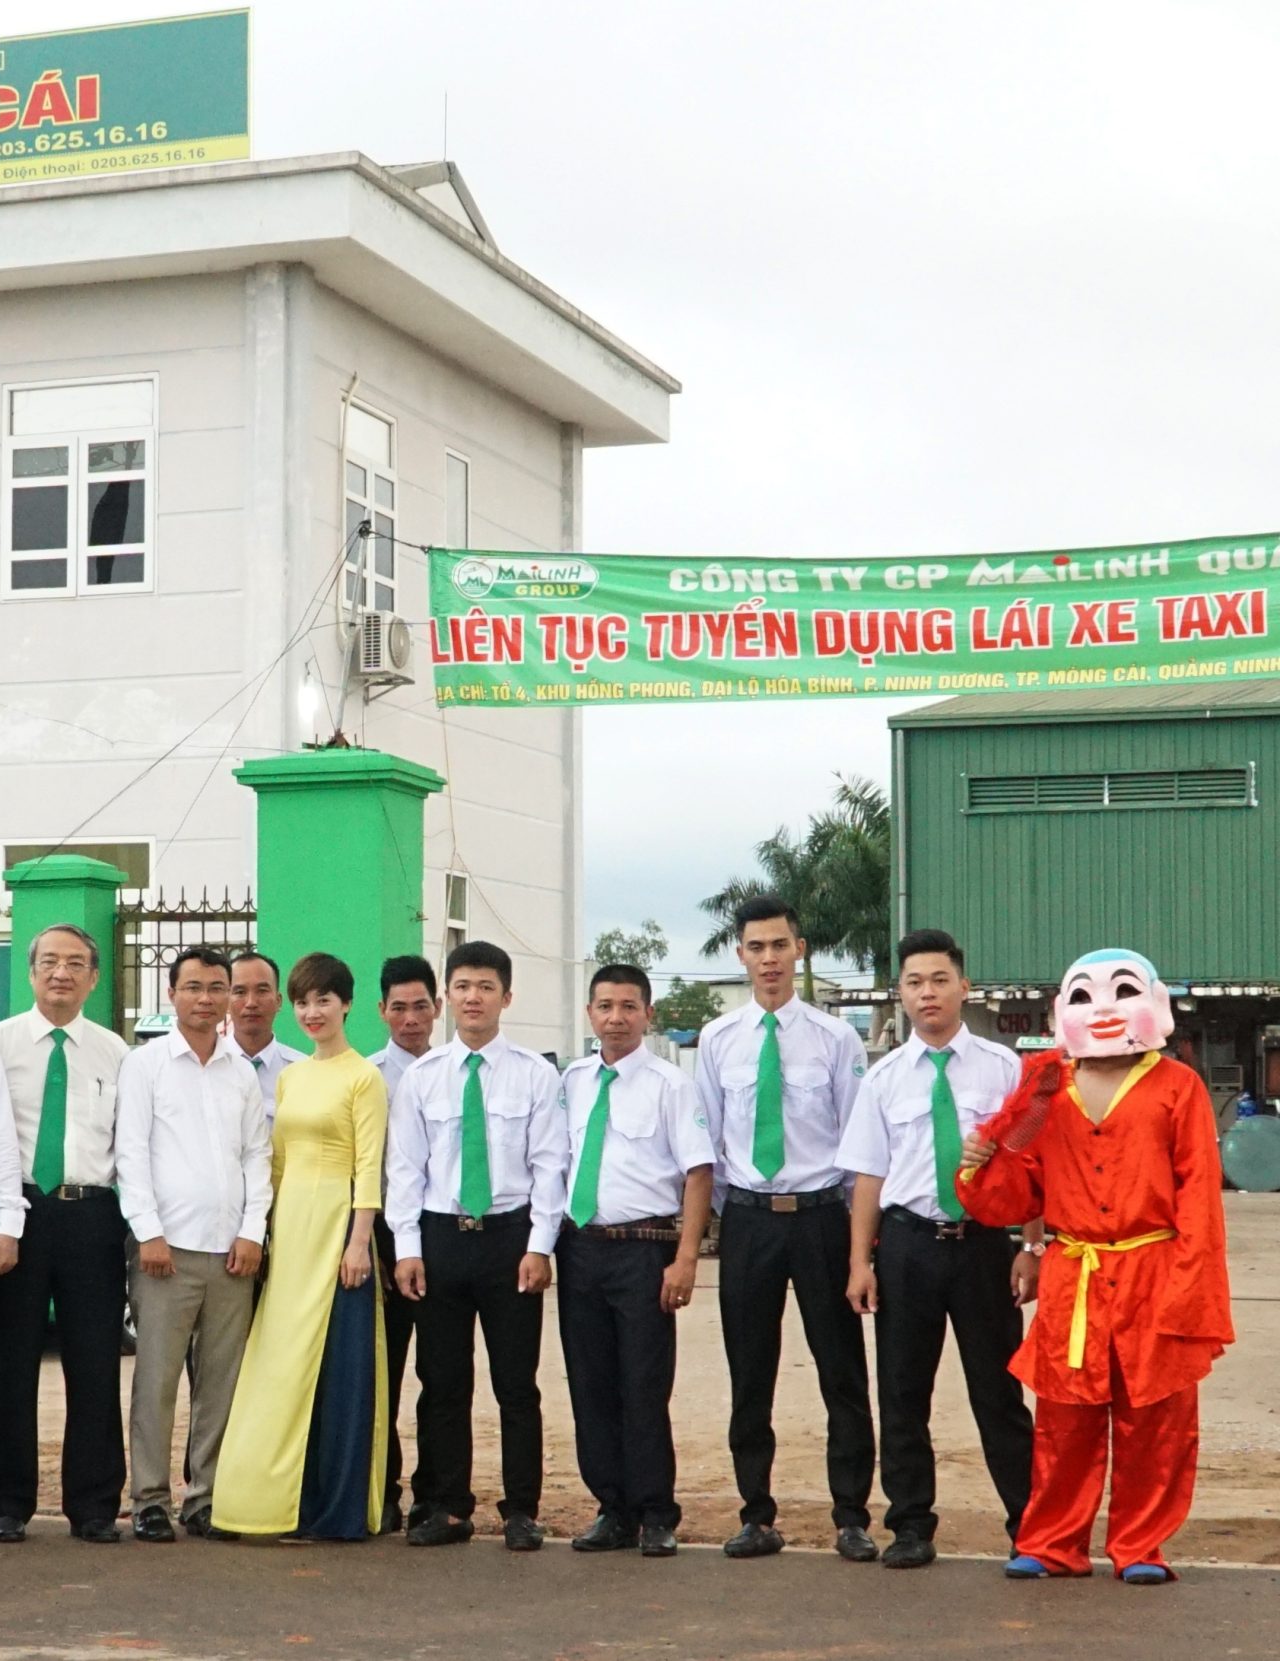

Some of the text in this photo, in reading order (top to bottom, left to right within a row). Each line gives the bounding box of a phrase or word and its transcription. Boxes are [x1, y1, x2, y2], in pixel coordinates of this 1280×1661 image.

[3, 147, 206, 180] Điện thoại: 0203.625.16.16
[515, 584, 581, 596] GROUP
[669, 563, 799, 592] CÔNG
[812, 565, 869, 592] TY
[884, 564, 949, 590] CP
[429, 588, 1268, 674] LIÊN TỤC TUYỂN DỤNG LÁI XE TAXI
[536, 684, 570, 700] KHU
[629, 680, 696, 698] PHONG,
[702, 680, 732, 699] ĐẠI
[864, 677, 879, 692] P.
[884, 675, 932, 691] NINH
[1016, 671, 1040, 686] TP.
[1233, 657, 1280, 675] NINH
